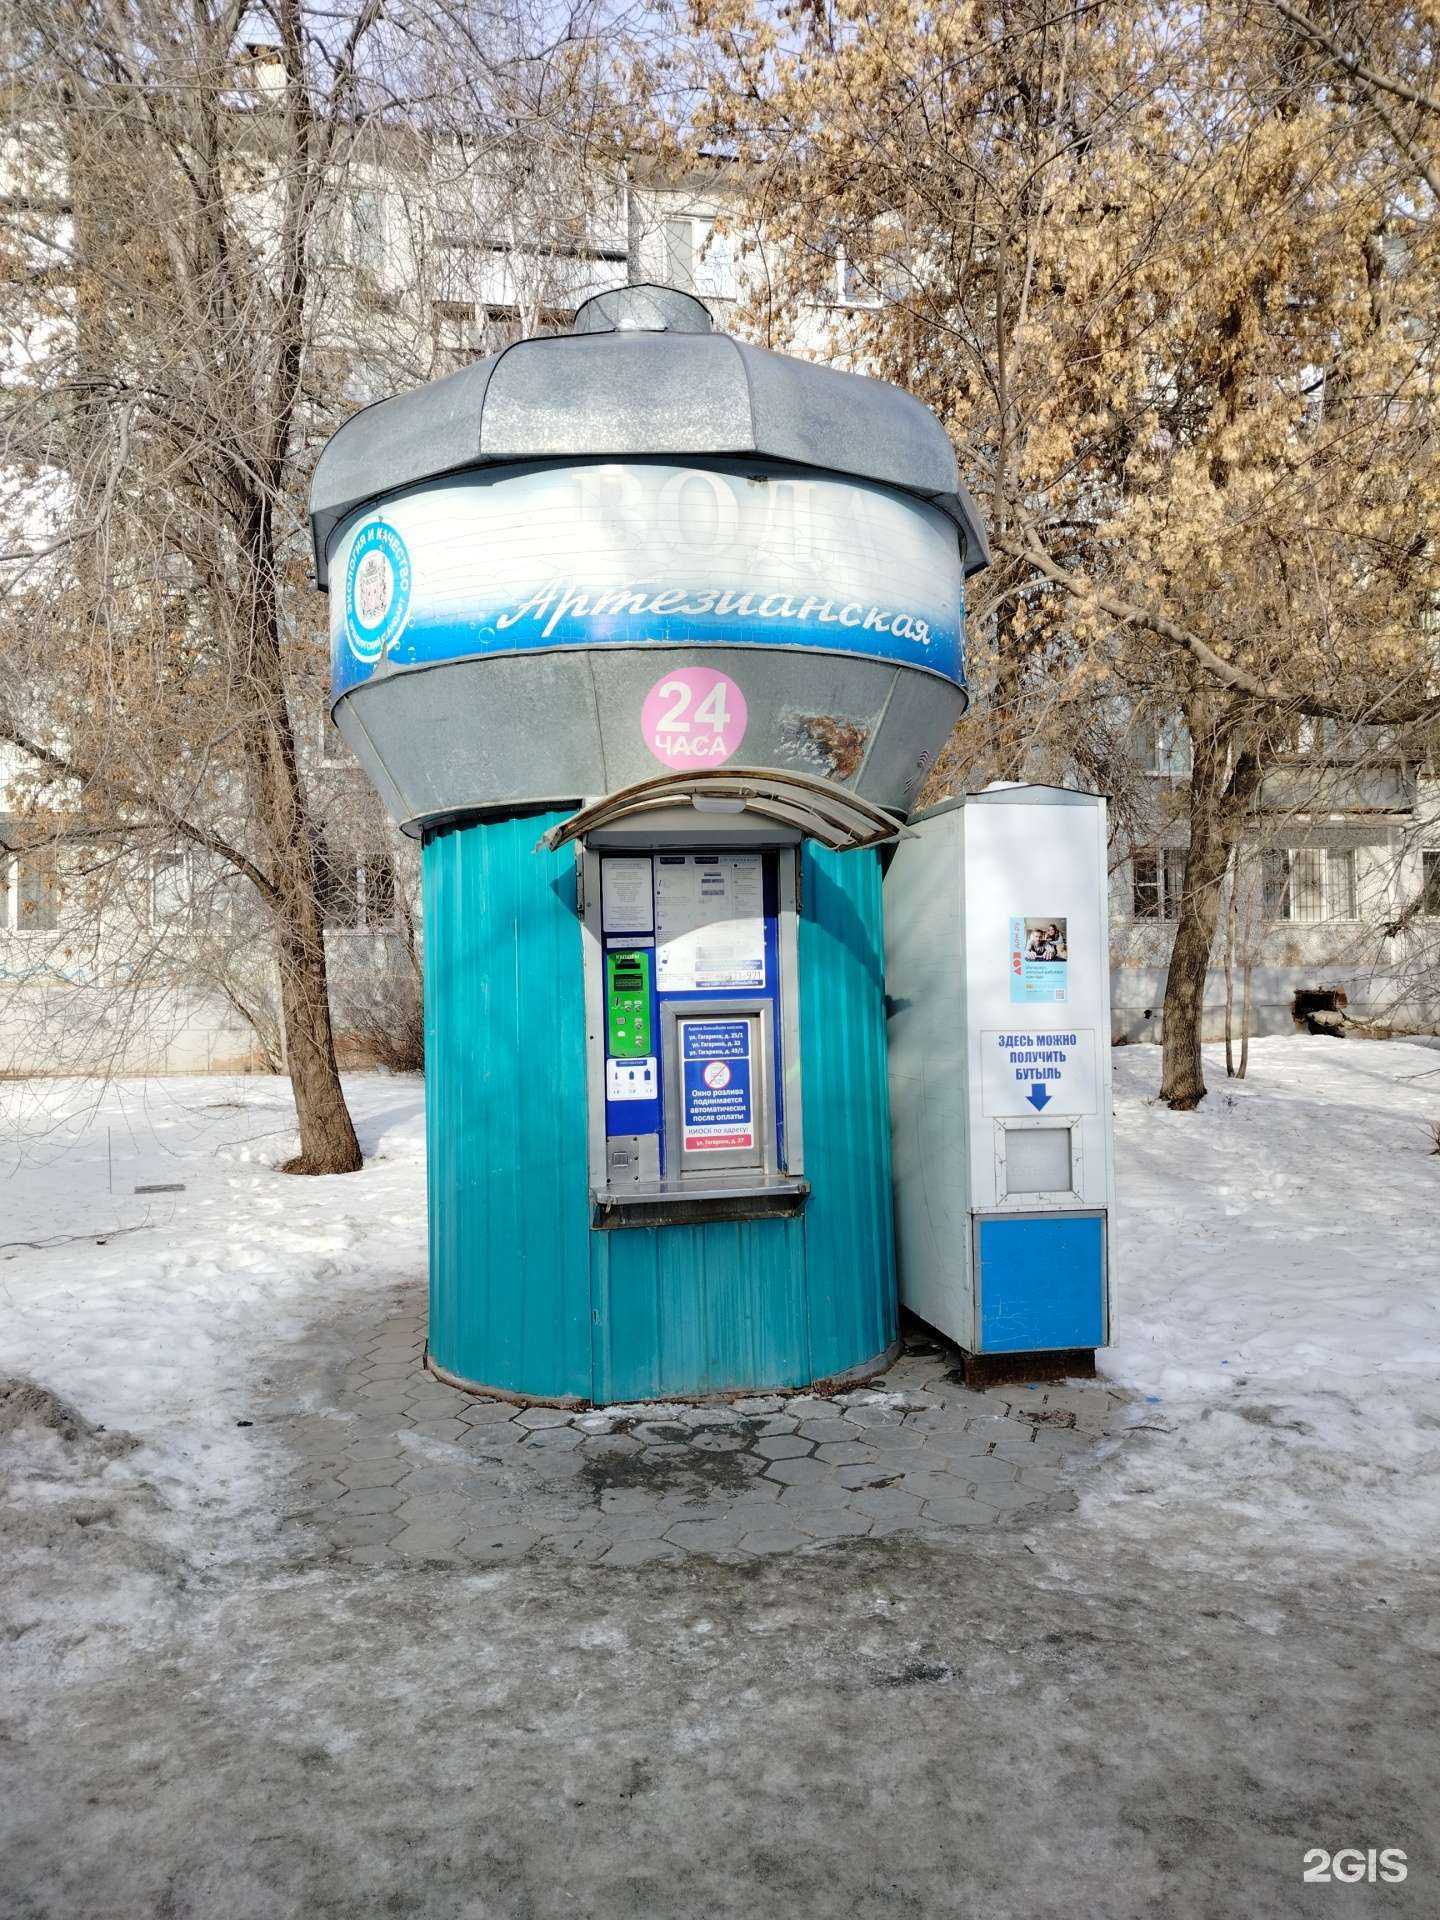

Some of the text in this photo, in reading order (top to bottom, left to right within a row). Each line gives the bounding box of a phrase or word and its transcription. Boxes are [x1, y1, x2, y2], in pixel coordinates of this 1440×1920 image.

[346, 535, 367, 613] ЭКОЛОГИЯ
[367, 528, 375, 541] И
[376, 528, 410, 592] КАЧЕСТВО
[497, 576, 932, 645] Артезианская
[656, 681, 731, 733] 24
[655, 734, 728, 757] ЧАСА
[998, 1034, 1077, 1048] ЗДЕСЬ МОЖНО
[1009, 1050, 1067, 1063] ПОЛУЧИТЬ
[1015, 1067, 1062, 1080] БУТЫЛЬ
[691, 1088, 744, 1097] Окно розлива
[693, 1097, 743, 1106] поднимается
[690, 1105, 746, 1114] автоматически
[716, 1113, 744, 1121] оплаты
